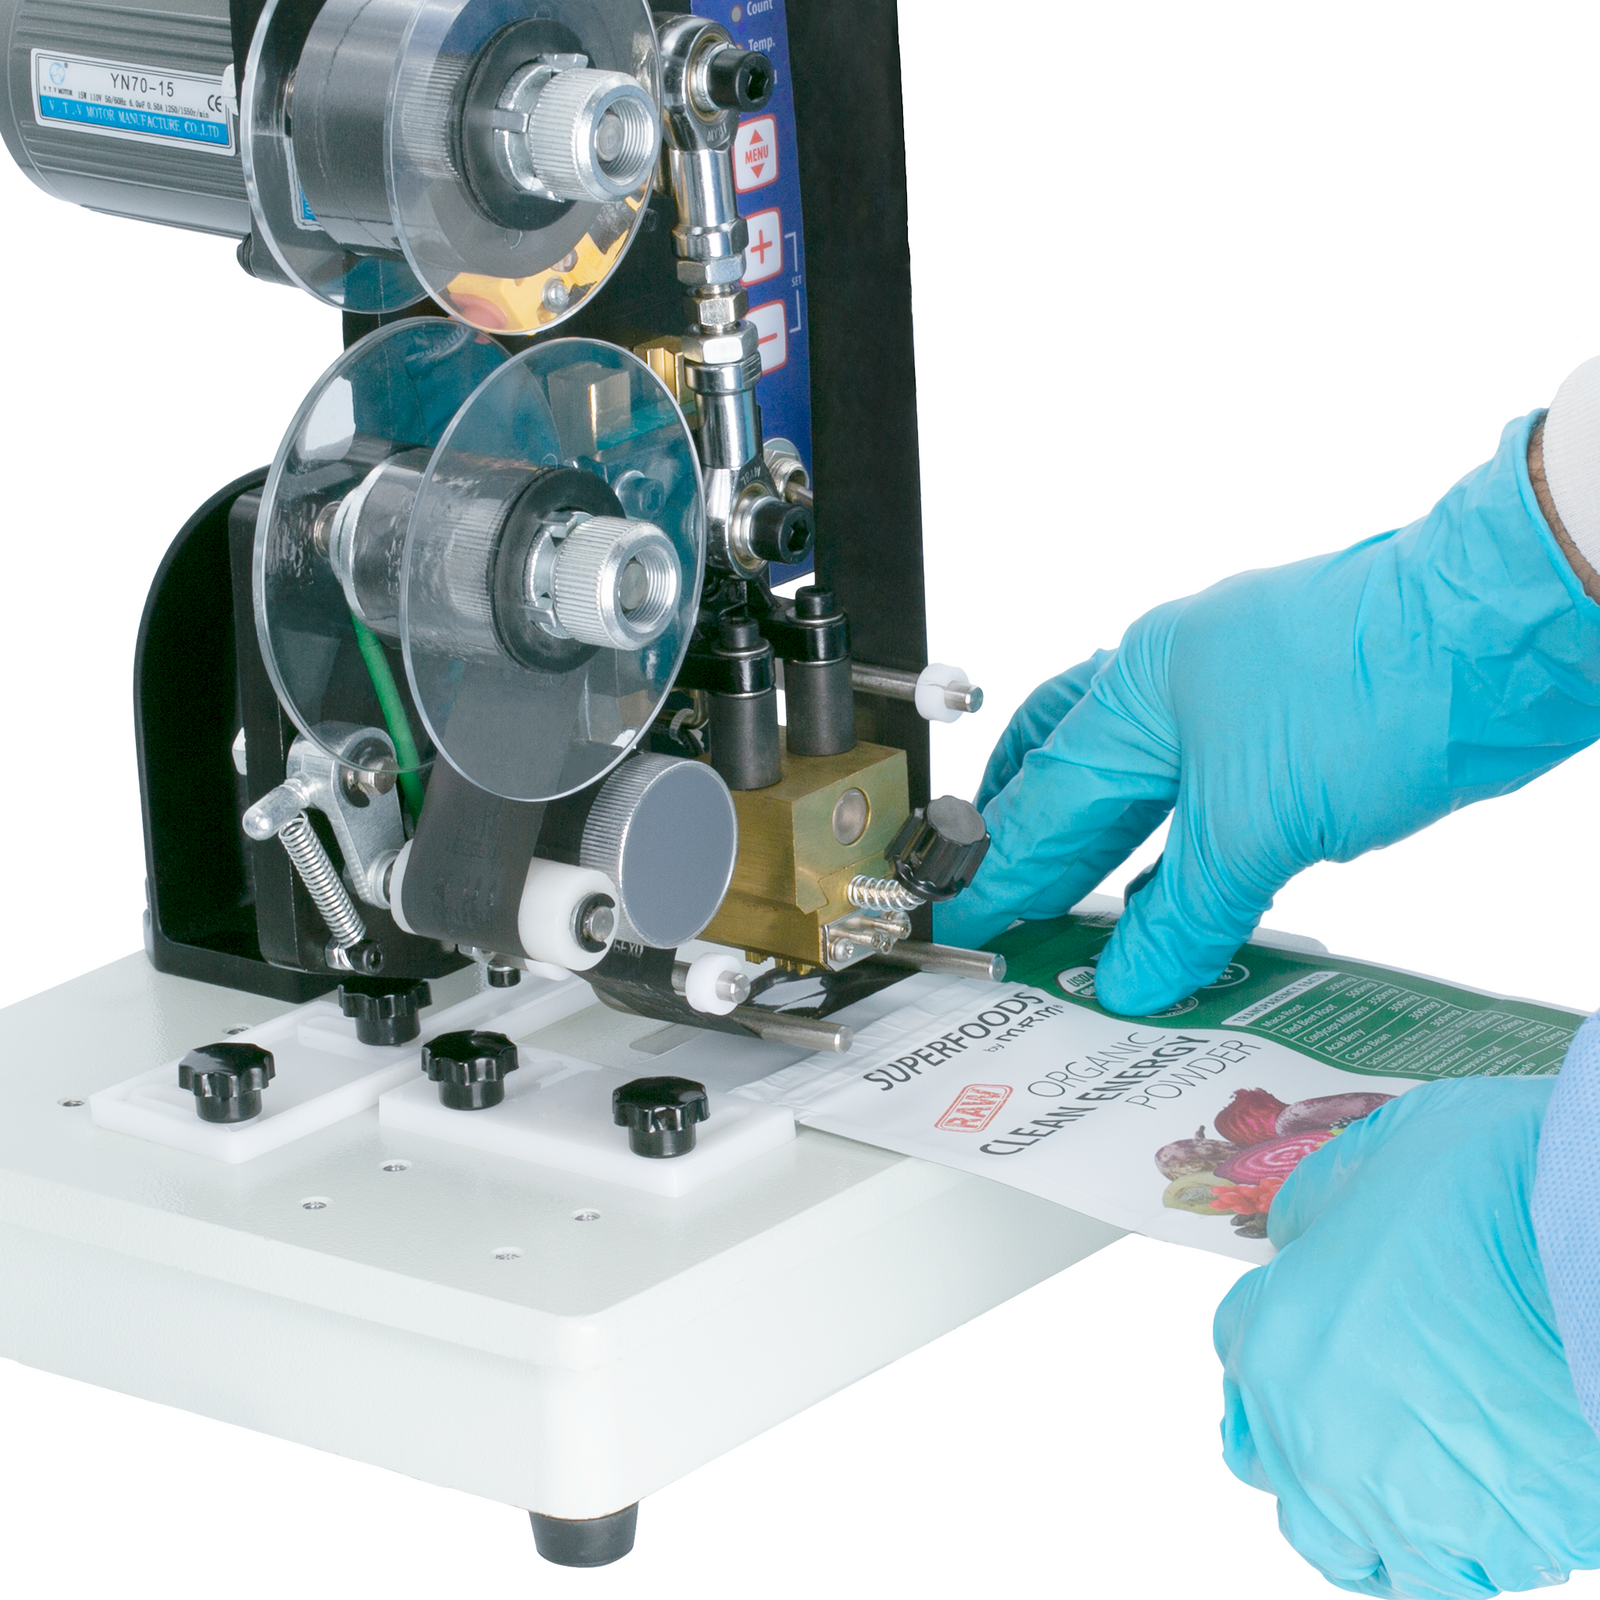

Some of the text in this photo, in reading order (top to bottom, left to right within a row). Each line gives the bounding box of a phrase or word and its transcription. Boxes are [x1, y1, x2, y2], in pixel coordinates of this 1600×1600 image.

[746, 0, 773, 16] Count
[748, 37, 776, 52] Temp.
[58, 88, 73, 96] MOTOR
[110, 73, 174, 97] YN70-15
[86, 105, 115, 121] MOTOR
[118, 111, 181, 132] MANUFACTURE
[745, 145, 769, 164] MENU
[791, 275, 801, 287] SET
[1066, 970, 1096, 987] USDA
[1232, 973, 1329, 1022] TRANSPARENCY FACTS
[1261, 976, 1358, 1027] Maca Root 500mg
[1281, 981, 1377, 1035] Red Beet Root 500mg
[1303, 1020, 1338, 1043] Cordyceps
[1367, 987, 1399, 1005] 350mg
[863, 992, 1044, 1091] SUPERFOODS
[1325, 994, 1420, 1052] Acai Berry 300mg
[1345, 1000, 1441, 1060] Cacao Bean 300mg
[1405, 1028, 1431, 1042] Berry
[1429, 1009, 1462, 1027] 300mg
[1514, 1024, 1547, 1039] 150mg
[983, 1042, 1005, 1053] by
[1429, 1019, 1525, 1071] Blackberry 150mg
[1495, 1053, 1522, 1066] Berry
[1536, 1030, 1568, 1045] 150mg
[1027, 1032, 1166, 1097] ORGANIC
[1125, 1039, 1262, 1110] POWDER
[944, 1088, 1004, 1128] RAW
[979, 1035, 1210, 1155] CLEAN ENERGY
